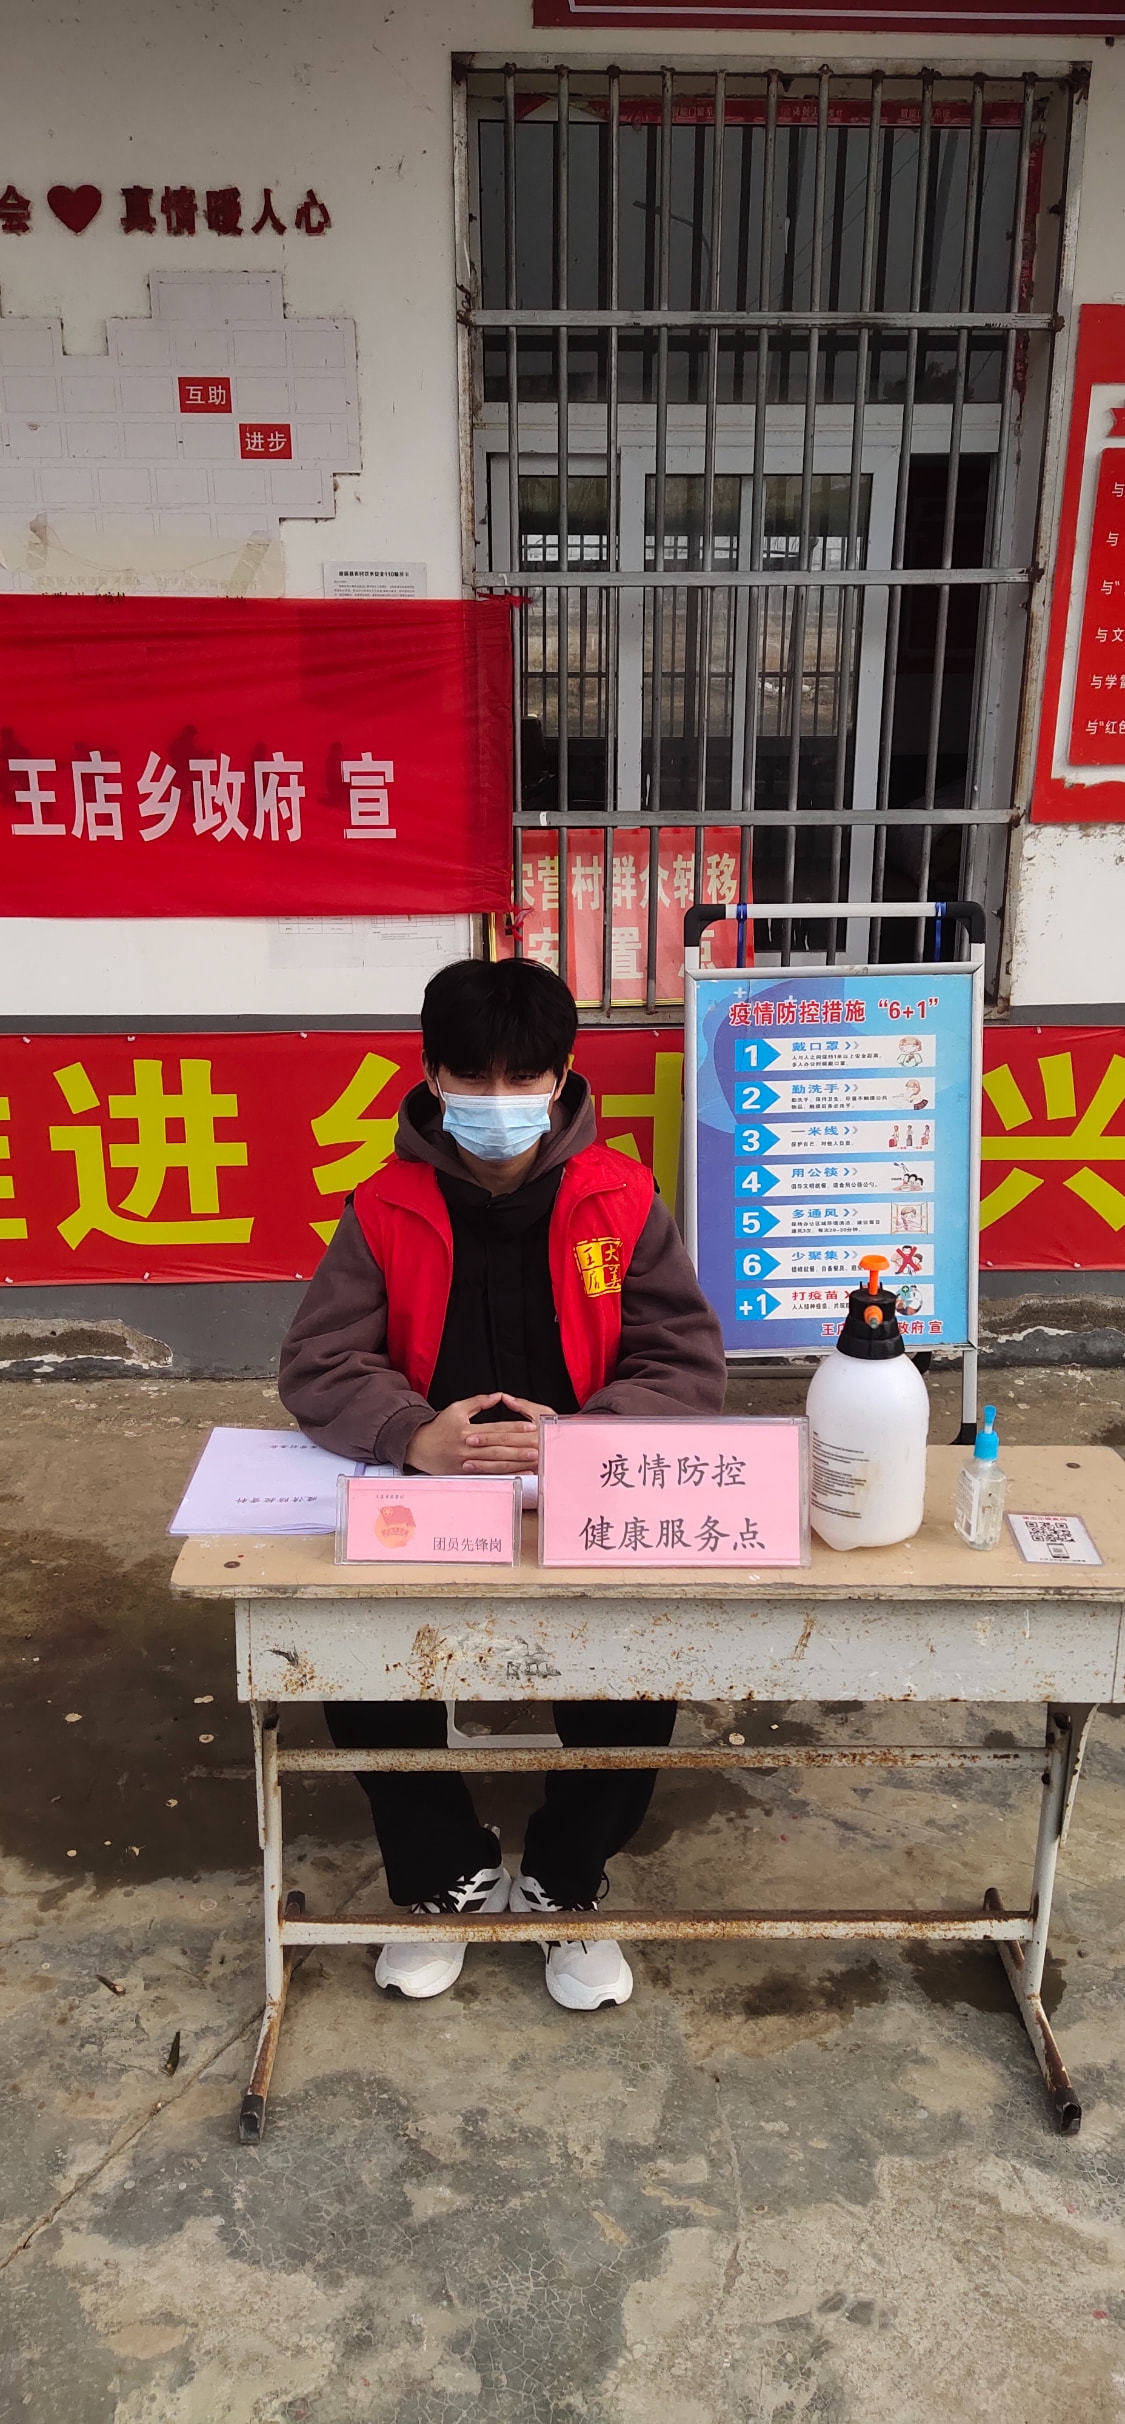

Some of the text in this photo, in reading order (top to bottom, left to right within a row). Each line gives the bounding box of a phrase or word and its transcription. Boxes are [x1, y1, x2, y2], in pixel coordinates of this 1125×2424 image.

[120, 185, 331, 236] 真情暖人心
[185, 385, 227, 406] 互助
[245, 431, 287, 453] 进步
[8, 750, 397, 843] 王店乡政府 宣
[729, 999, 866, 1026] 疫情防控措施
[744, 1041, 840, 1067] 1 戴口罩
[742, 1083, 840, 1109] 2 勤洗手
[742, 1126, 839, 1152] 3 一米线
[741, 1167, 839, 1193] 4 用公筷
[742, 1208, 839, 1234] 5 多通风
[743, 1250, 839, 1276] 6 少聚集
[739, 1290, 838, 1316] +1 打疫苗
[928, 1320, 943, 1335] 宣
[600, 1453, 747, 1489] 疫情防控
[432, 1536, 502, 1554] 团员先锋岗
[578, 1515, 766, 1553] 健康服务点
